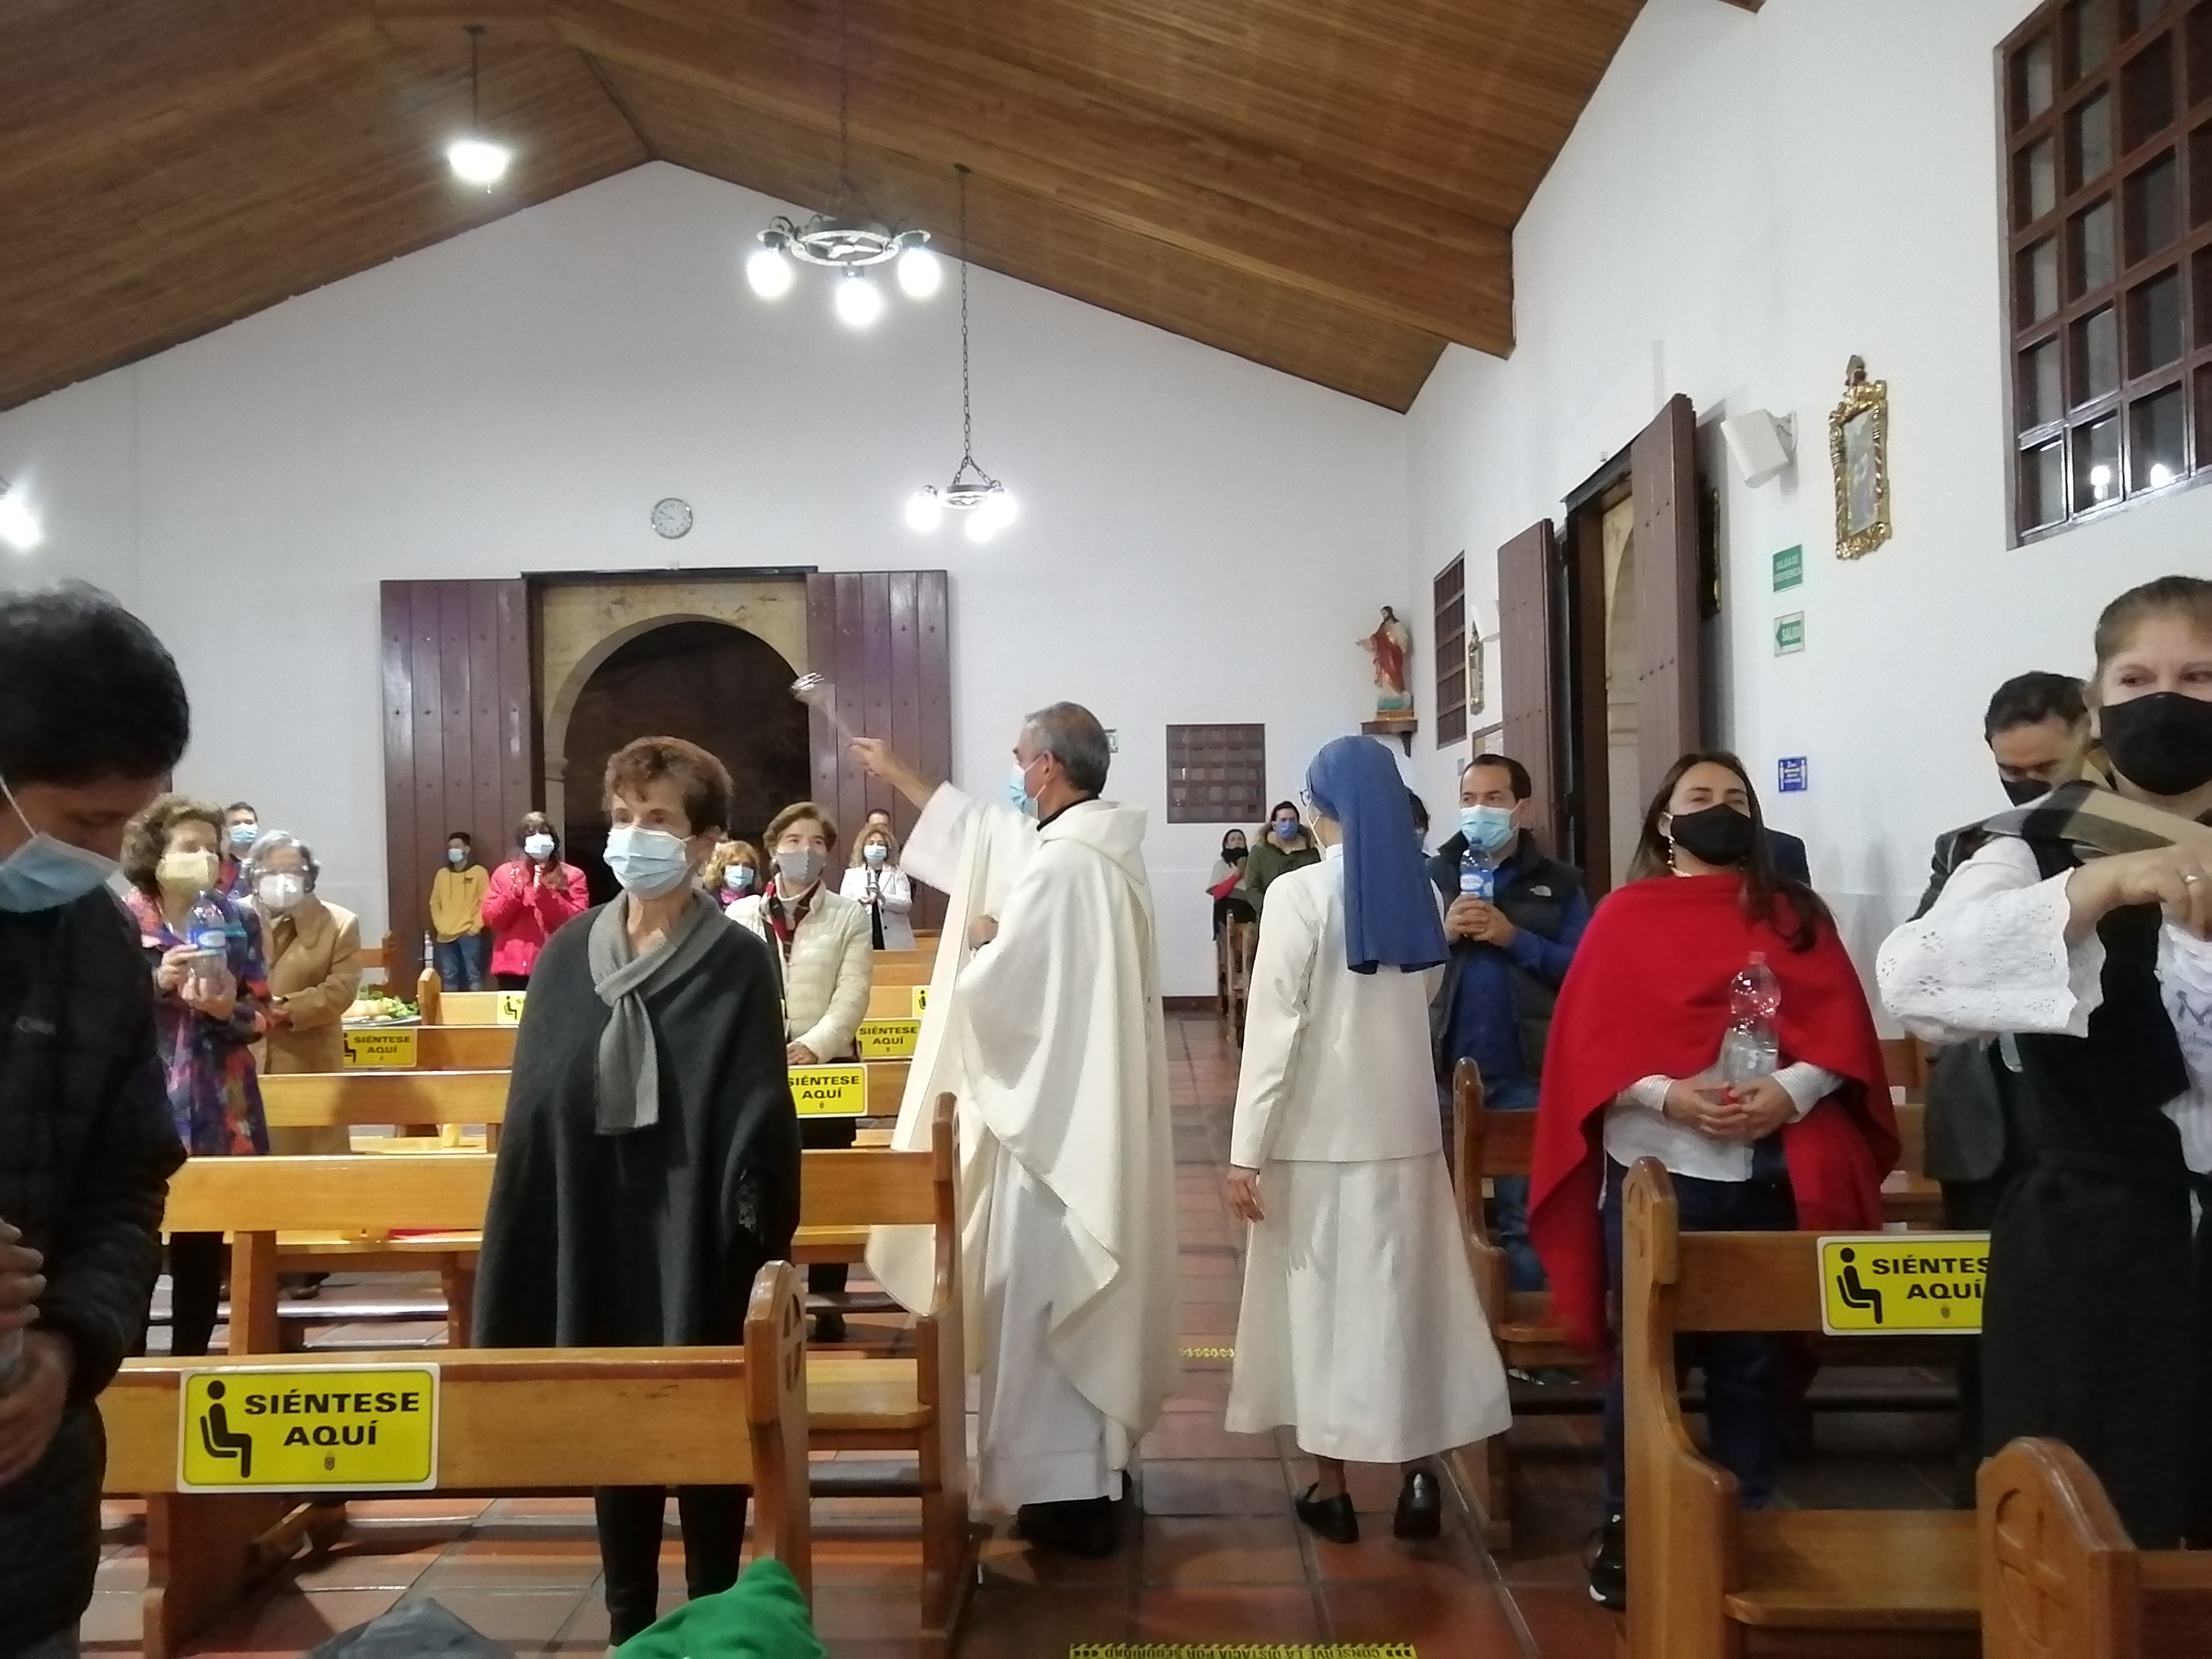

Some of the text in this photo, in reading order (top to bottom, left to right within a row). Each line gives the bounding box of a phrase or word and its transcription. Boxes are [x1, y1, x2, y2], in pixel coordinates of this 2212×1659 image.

[859, 1026, 917, 1035] SIÉNTESE
[353, 1035, 410, 1044] SIÉNTESE
[872, 1035, 903, 1045] AQUÍ
[366, 1045, 397, 1053] AQUÍ
[788, 1075, 859, 1086] SIÉNTESE
[802, 1087, 842, 1099] AQUÍ
[1872, 1254, 1988, 1274] SIÉNTES
[1906, 1278, 1981, 1299] AQUÍ
[244, 1389, 420, 1415] SIÉNTESE
[283, 1420, 378, 1446] AQUÍ
